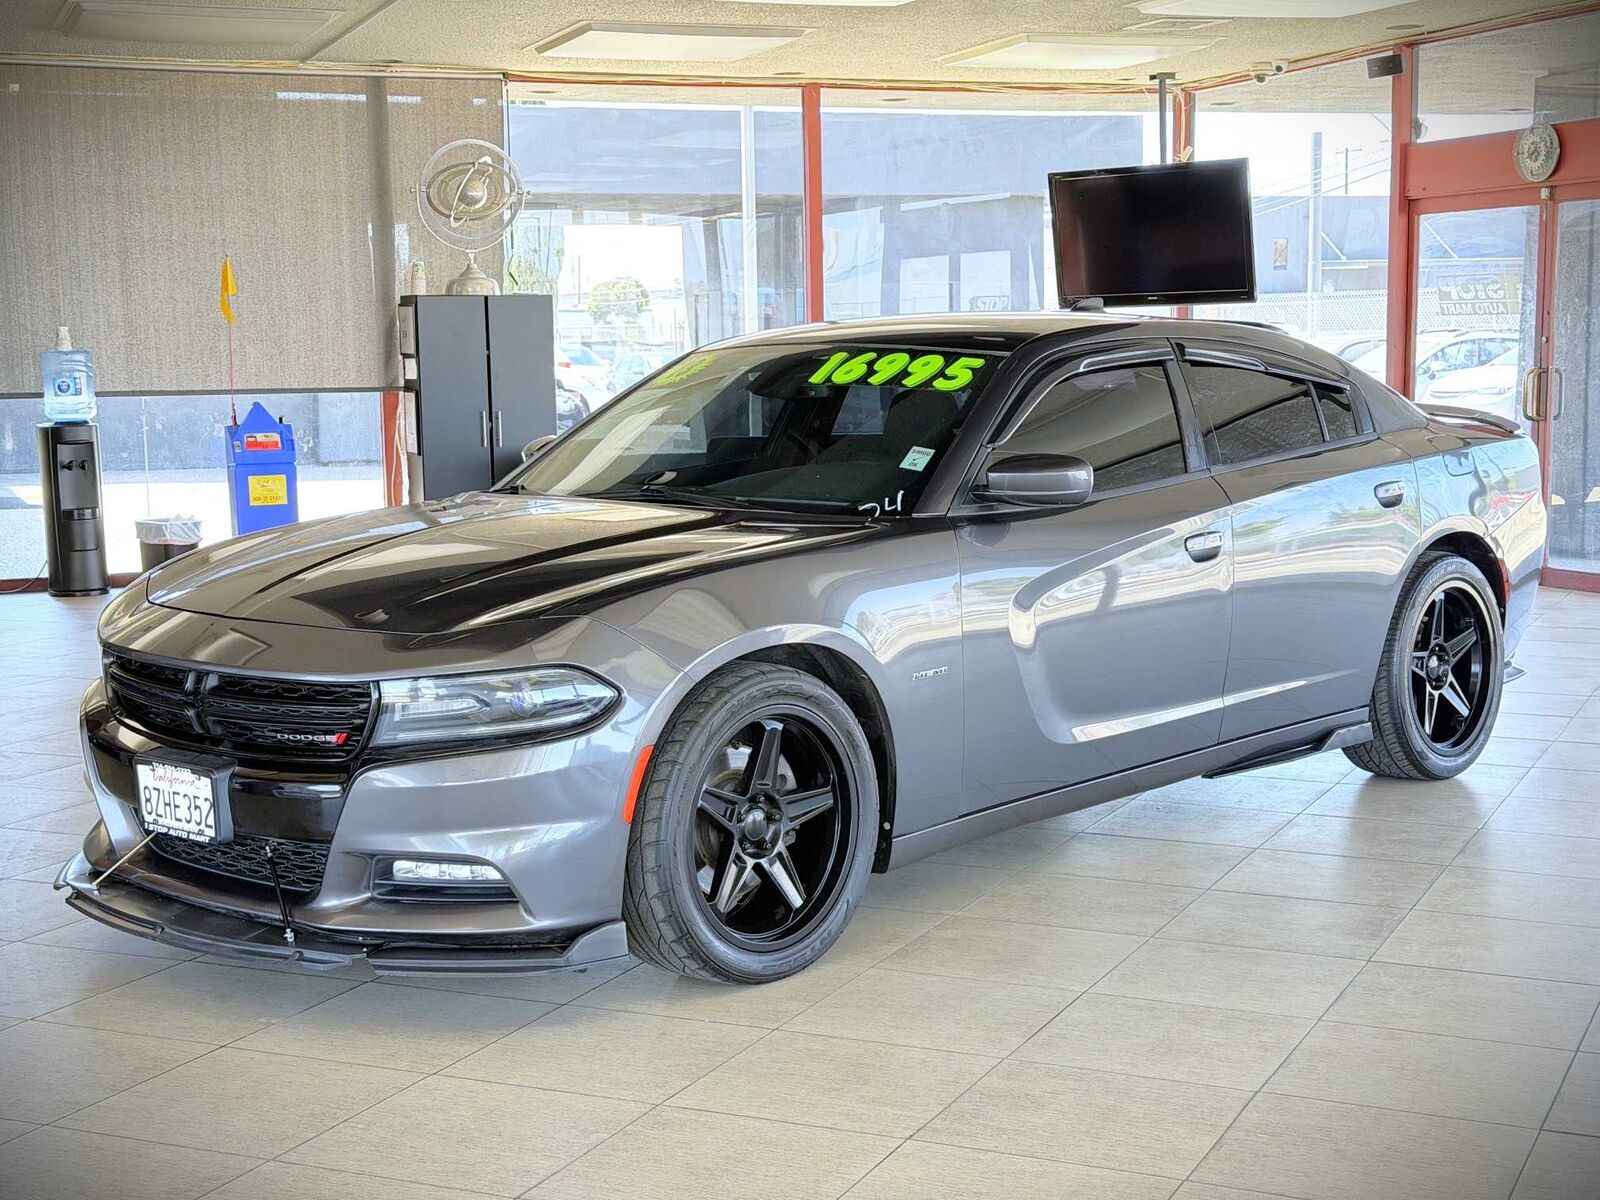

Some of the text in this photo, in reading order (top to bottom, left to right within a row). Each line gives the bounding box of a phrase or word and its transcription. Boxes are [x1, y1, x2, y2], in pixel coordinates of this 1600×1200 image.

[808, 352, 985, 391] 16995
[911, 449, 931, 457] SMOG
[276, 733, 337, 743] DODGE
[143, 785, 214, 829] 8ZHE352
[148, 823, 169, 834] STOP
[168, 828, 188, 839] AUTO
[188, 832, 210, 843] MART
